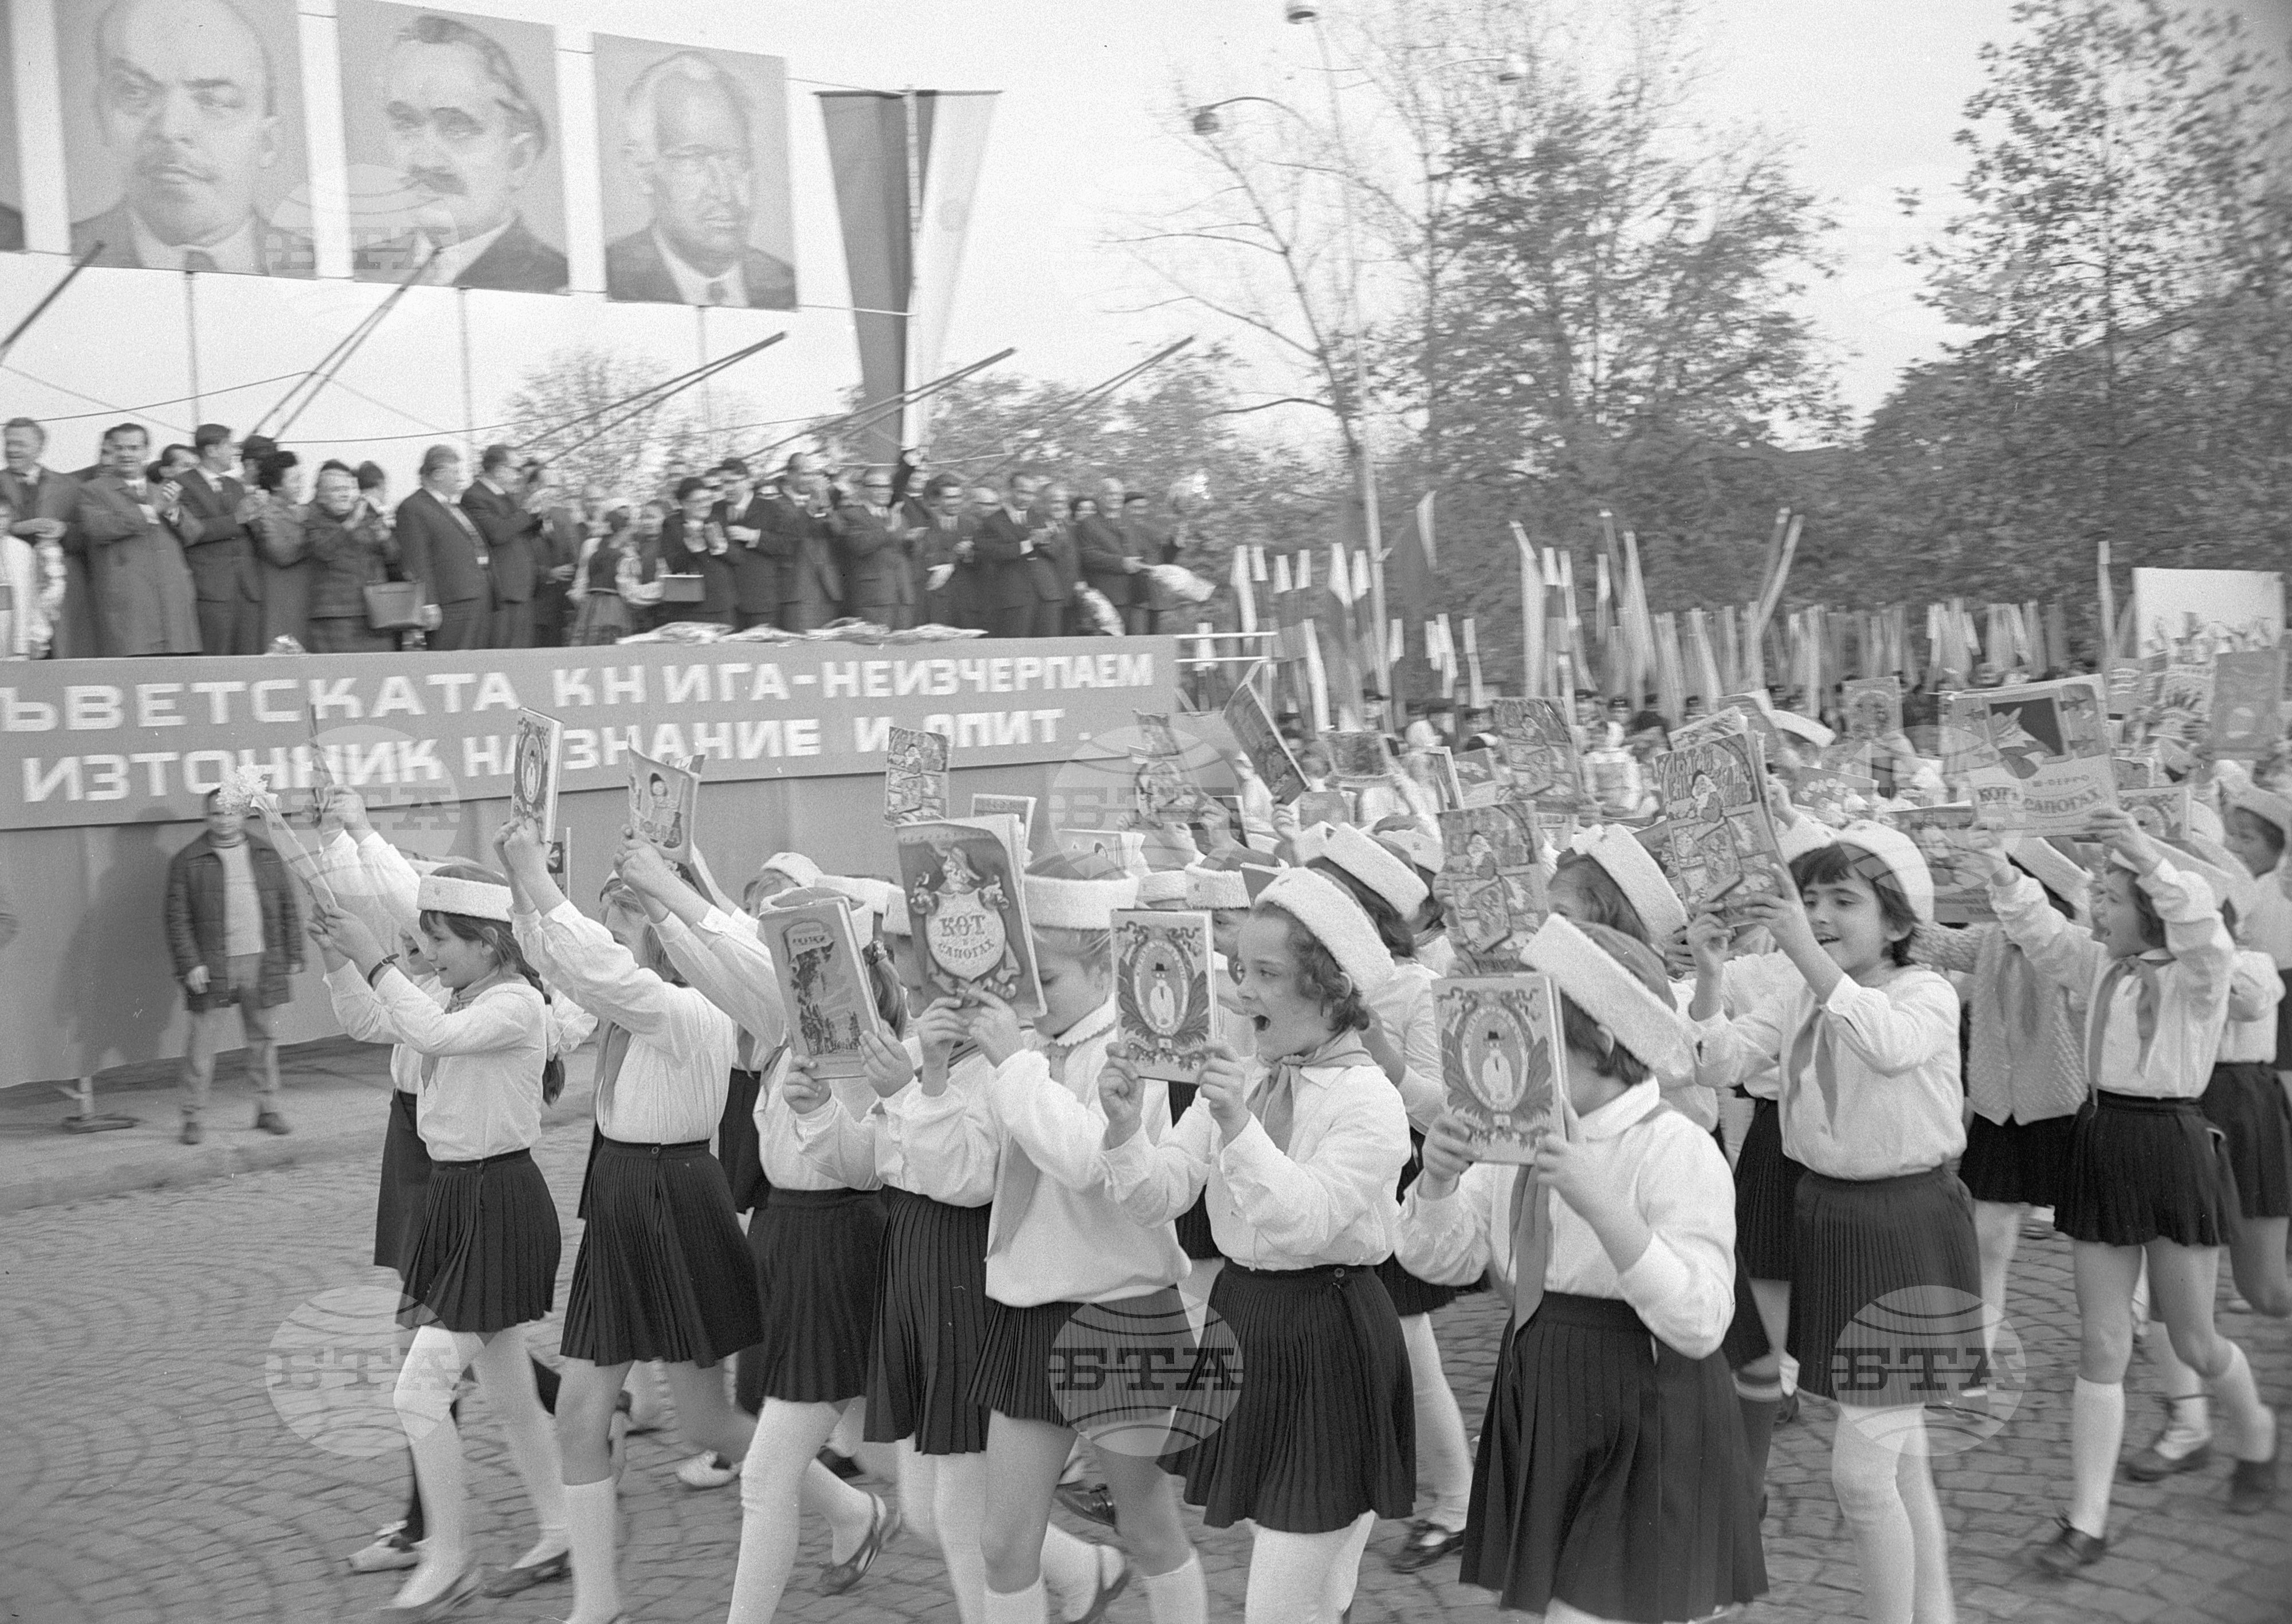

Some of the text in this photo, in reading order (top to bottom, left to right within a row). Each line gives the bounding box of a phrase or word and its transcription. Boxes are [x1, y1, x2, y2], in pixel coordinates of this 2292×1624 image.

[563, 719, 820, 770] ЗНАНИЕ
[854, 716, 895, 752] И
[939, 915, 986, 937] КОТ
